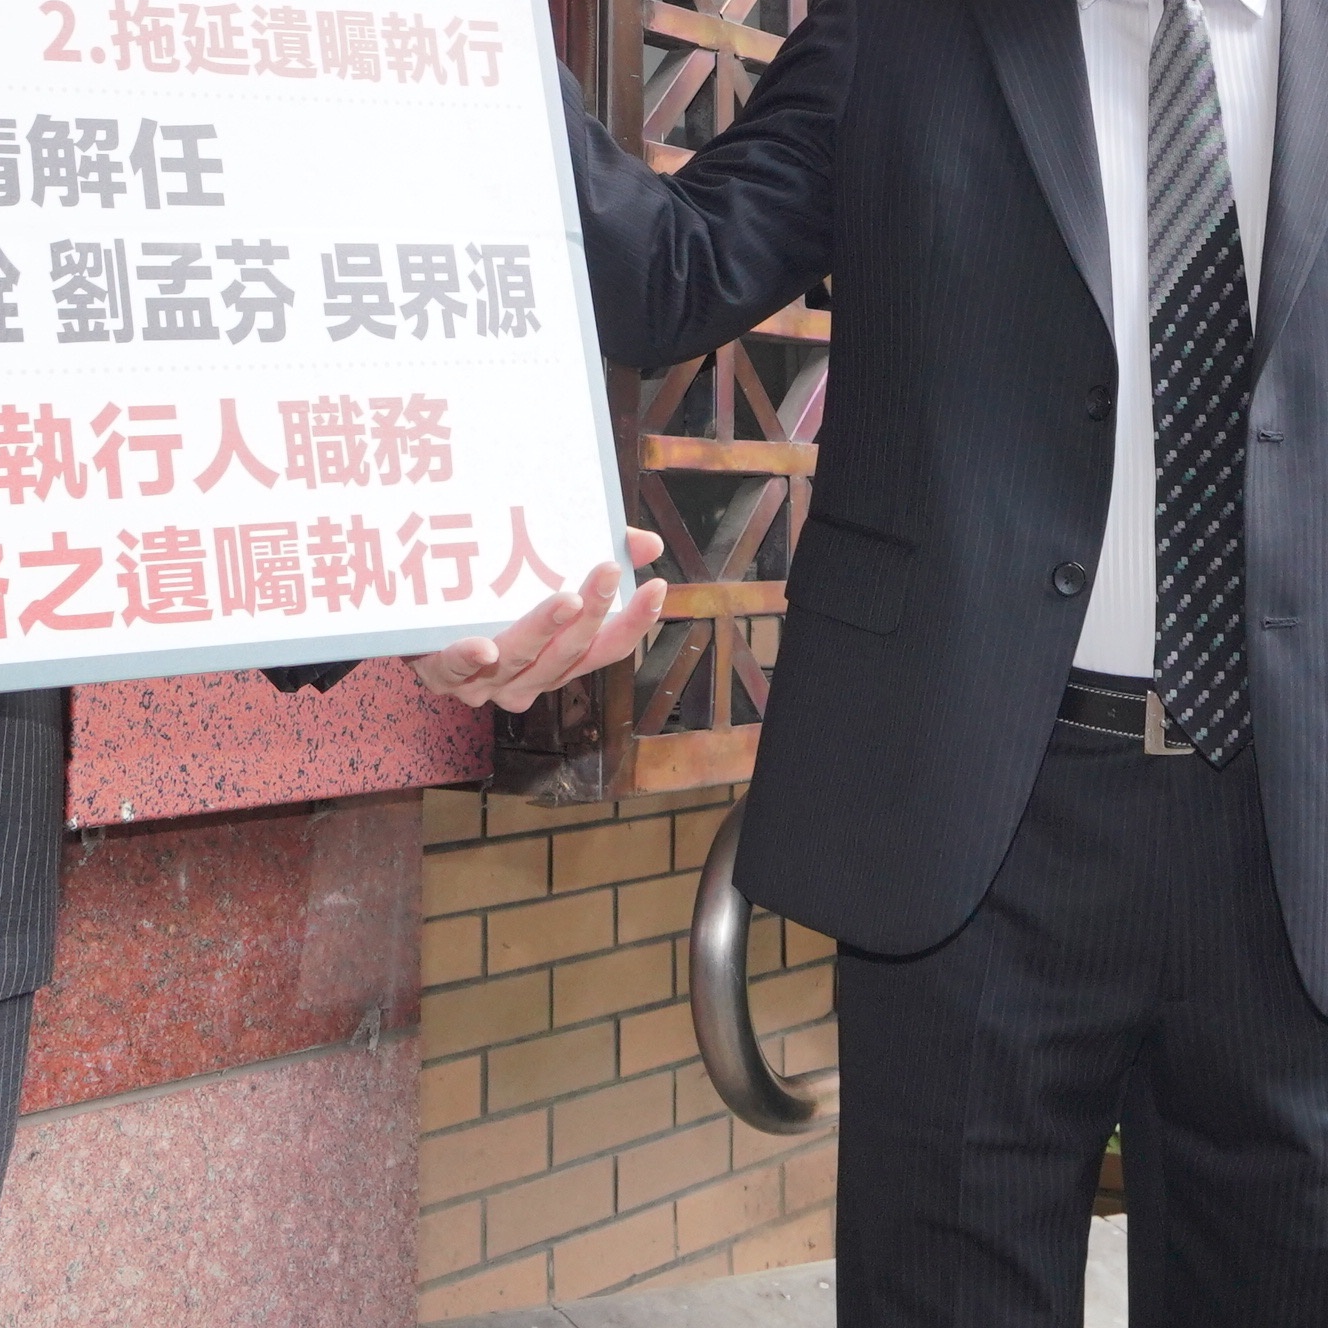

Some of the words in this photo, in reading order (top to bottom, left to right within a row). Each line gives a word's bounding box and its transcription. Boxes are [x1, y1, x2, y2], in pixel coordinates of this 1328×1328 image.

[49, 238, 296, 345] 劉孟芬
[320, 241, 542, 341] 吳界源
